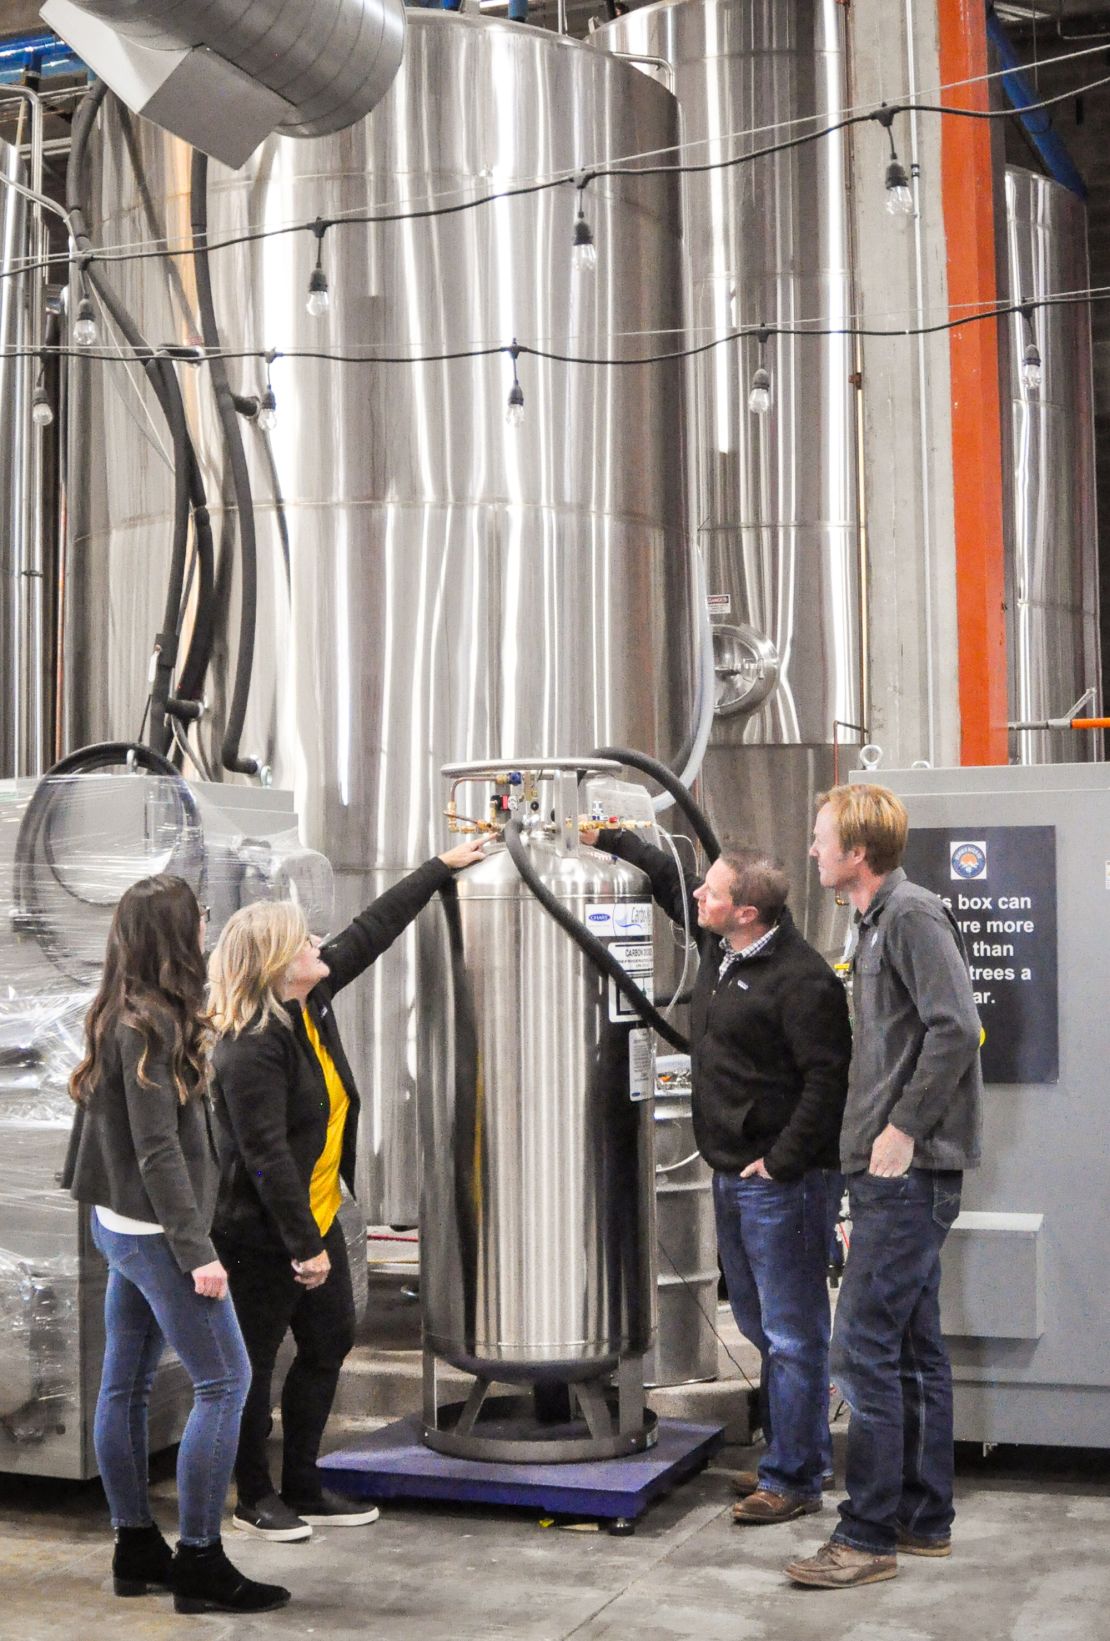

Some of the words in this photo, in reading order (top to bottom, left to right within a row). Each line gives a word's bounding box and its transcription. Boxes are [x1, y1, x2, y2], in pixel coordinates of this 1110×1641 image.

[958, 894, 993, 909] box
[998, 896, 1031, 909] can
[986, 920, 1034, 933] more
[973, 941, 1014, 957] than
[969, 965, 1015, 980] trees
[1020, 967, 1032, 980] a
